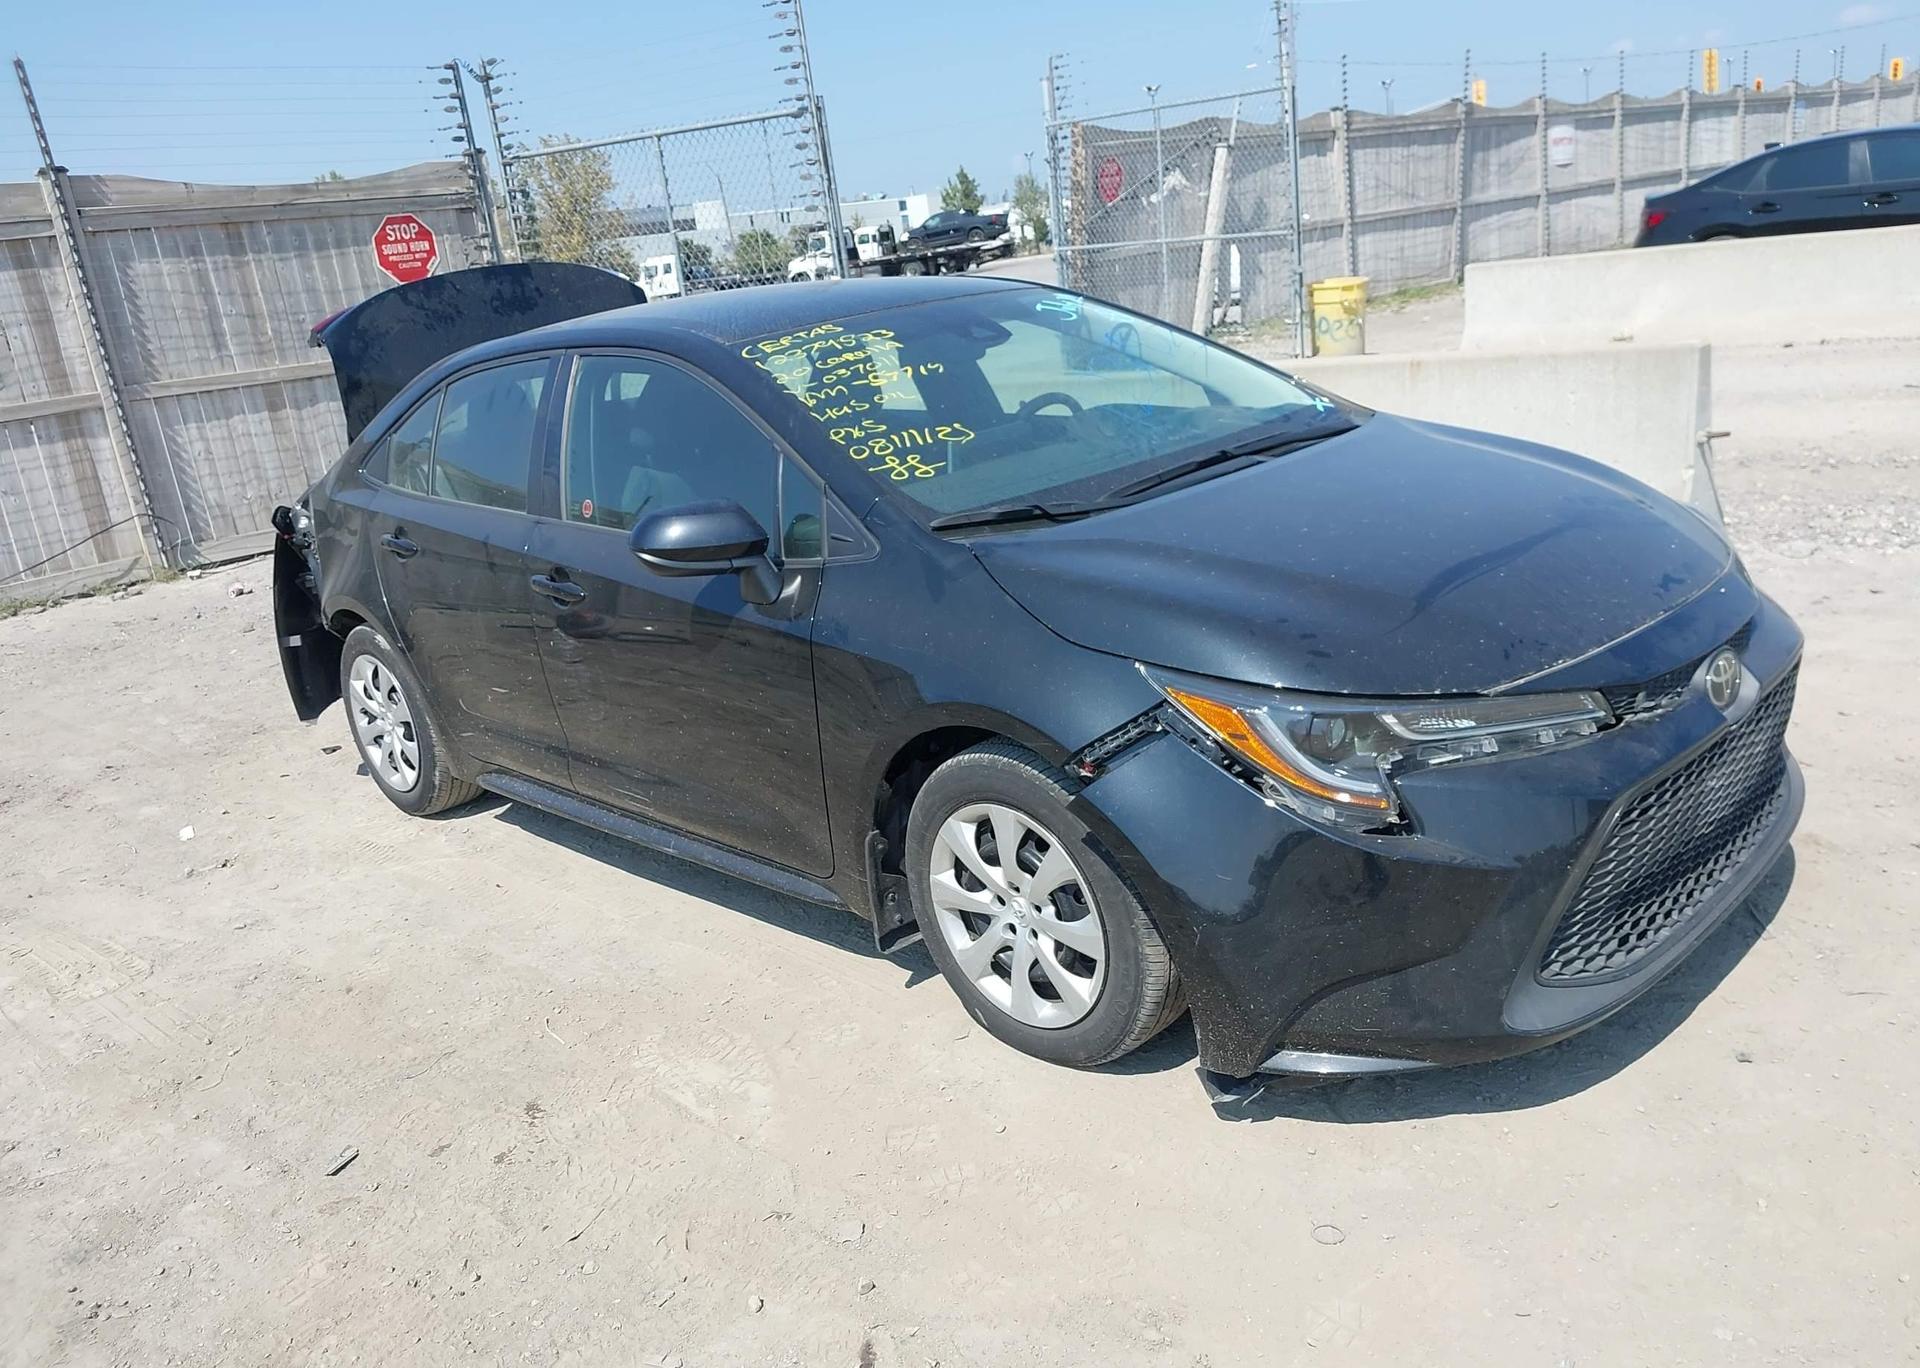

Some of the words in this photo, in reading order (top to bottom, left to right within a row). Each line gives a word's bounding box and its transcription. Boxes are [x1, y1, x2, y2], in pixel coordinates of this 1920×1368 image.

[385, 222, 418, 241] STOP
[382, 243, 408, 255] SOUND
[741, 324, 844, 359] CERTAS
